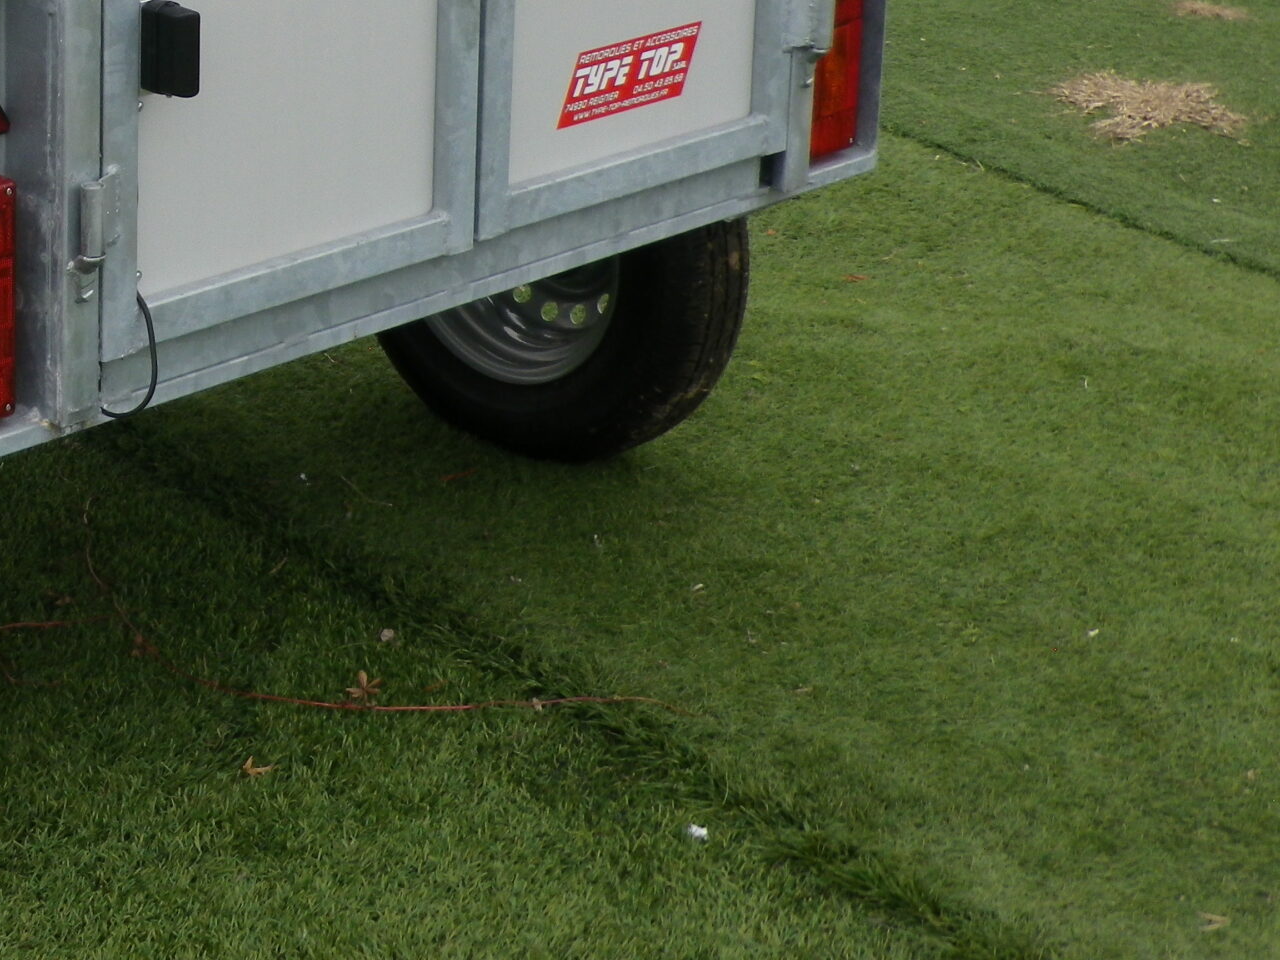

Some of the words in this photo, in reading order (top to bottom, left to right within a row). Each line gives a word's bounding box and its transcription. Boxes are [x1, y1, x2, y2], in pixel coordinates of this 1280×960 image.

[579, 43, 632, 65] REMORQUES
[633, 40, 643, 51] ET
[645, 25, 699, 47] ACCESSOIRES
[572, 55, 633, 98] TYPE
[638, 42, 685, 80] TOP
